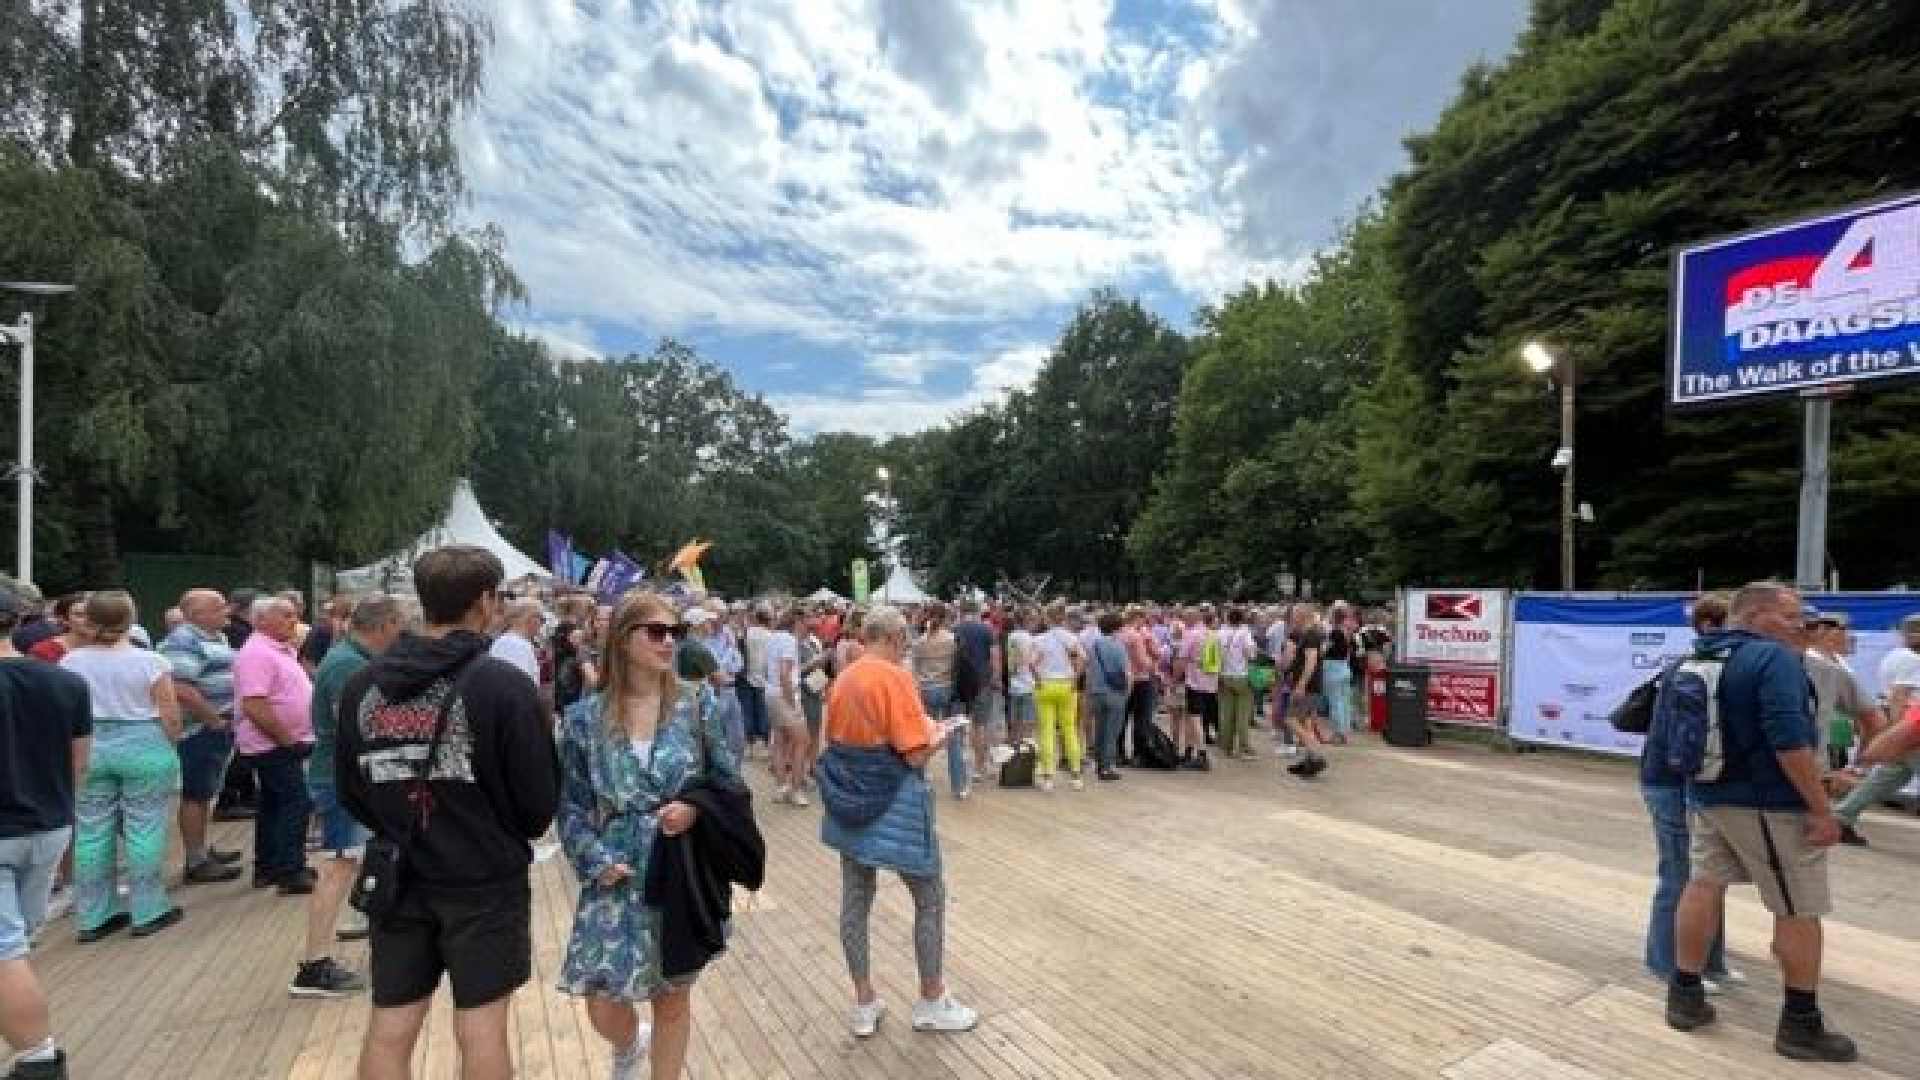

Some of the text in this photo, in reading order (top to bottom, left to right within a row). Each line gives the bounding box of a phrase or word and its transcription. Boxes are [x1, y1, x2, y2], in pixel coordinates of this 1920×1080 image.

[1741, 206, 1920, 311] DE 4
[1684, 374, 1732, 394] The
[1737, 359, 1803, 386] Walk
[1809, 352, 1843, 377] of
[1848, 347, 1901, 370] the
[1415, 622, 1492, 644] Techno
